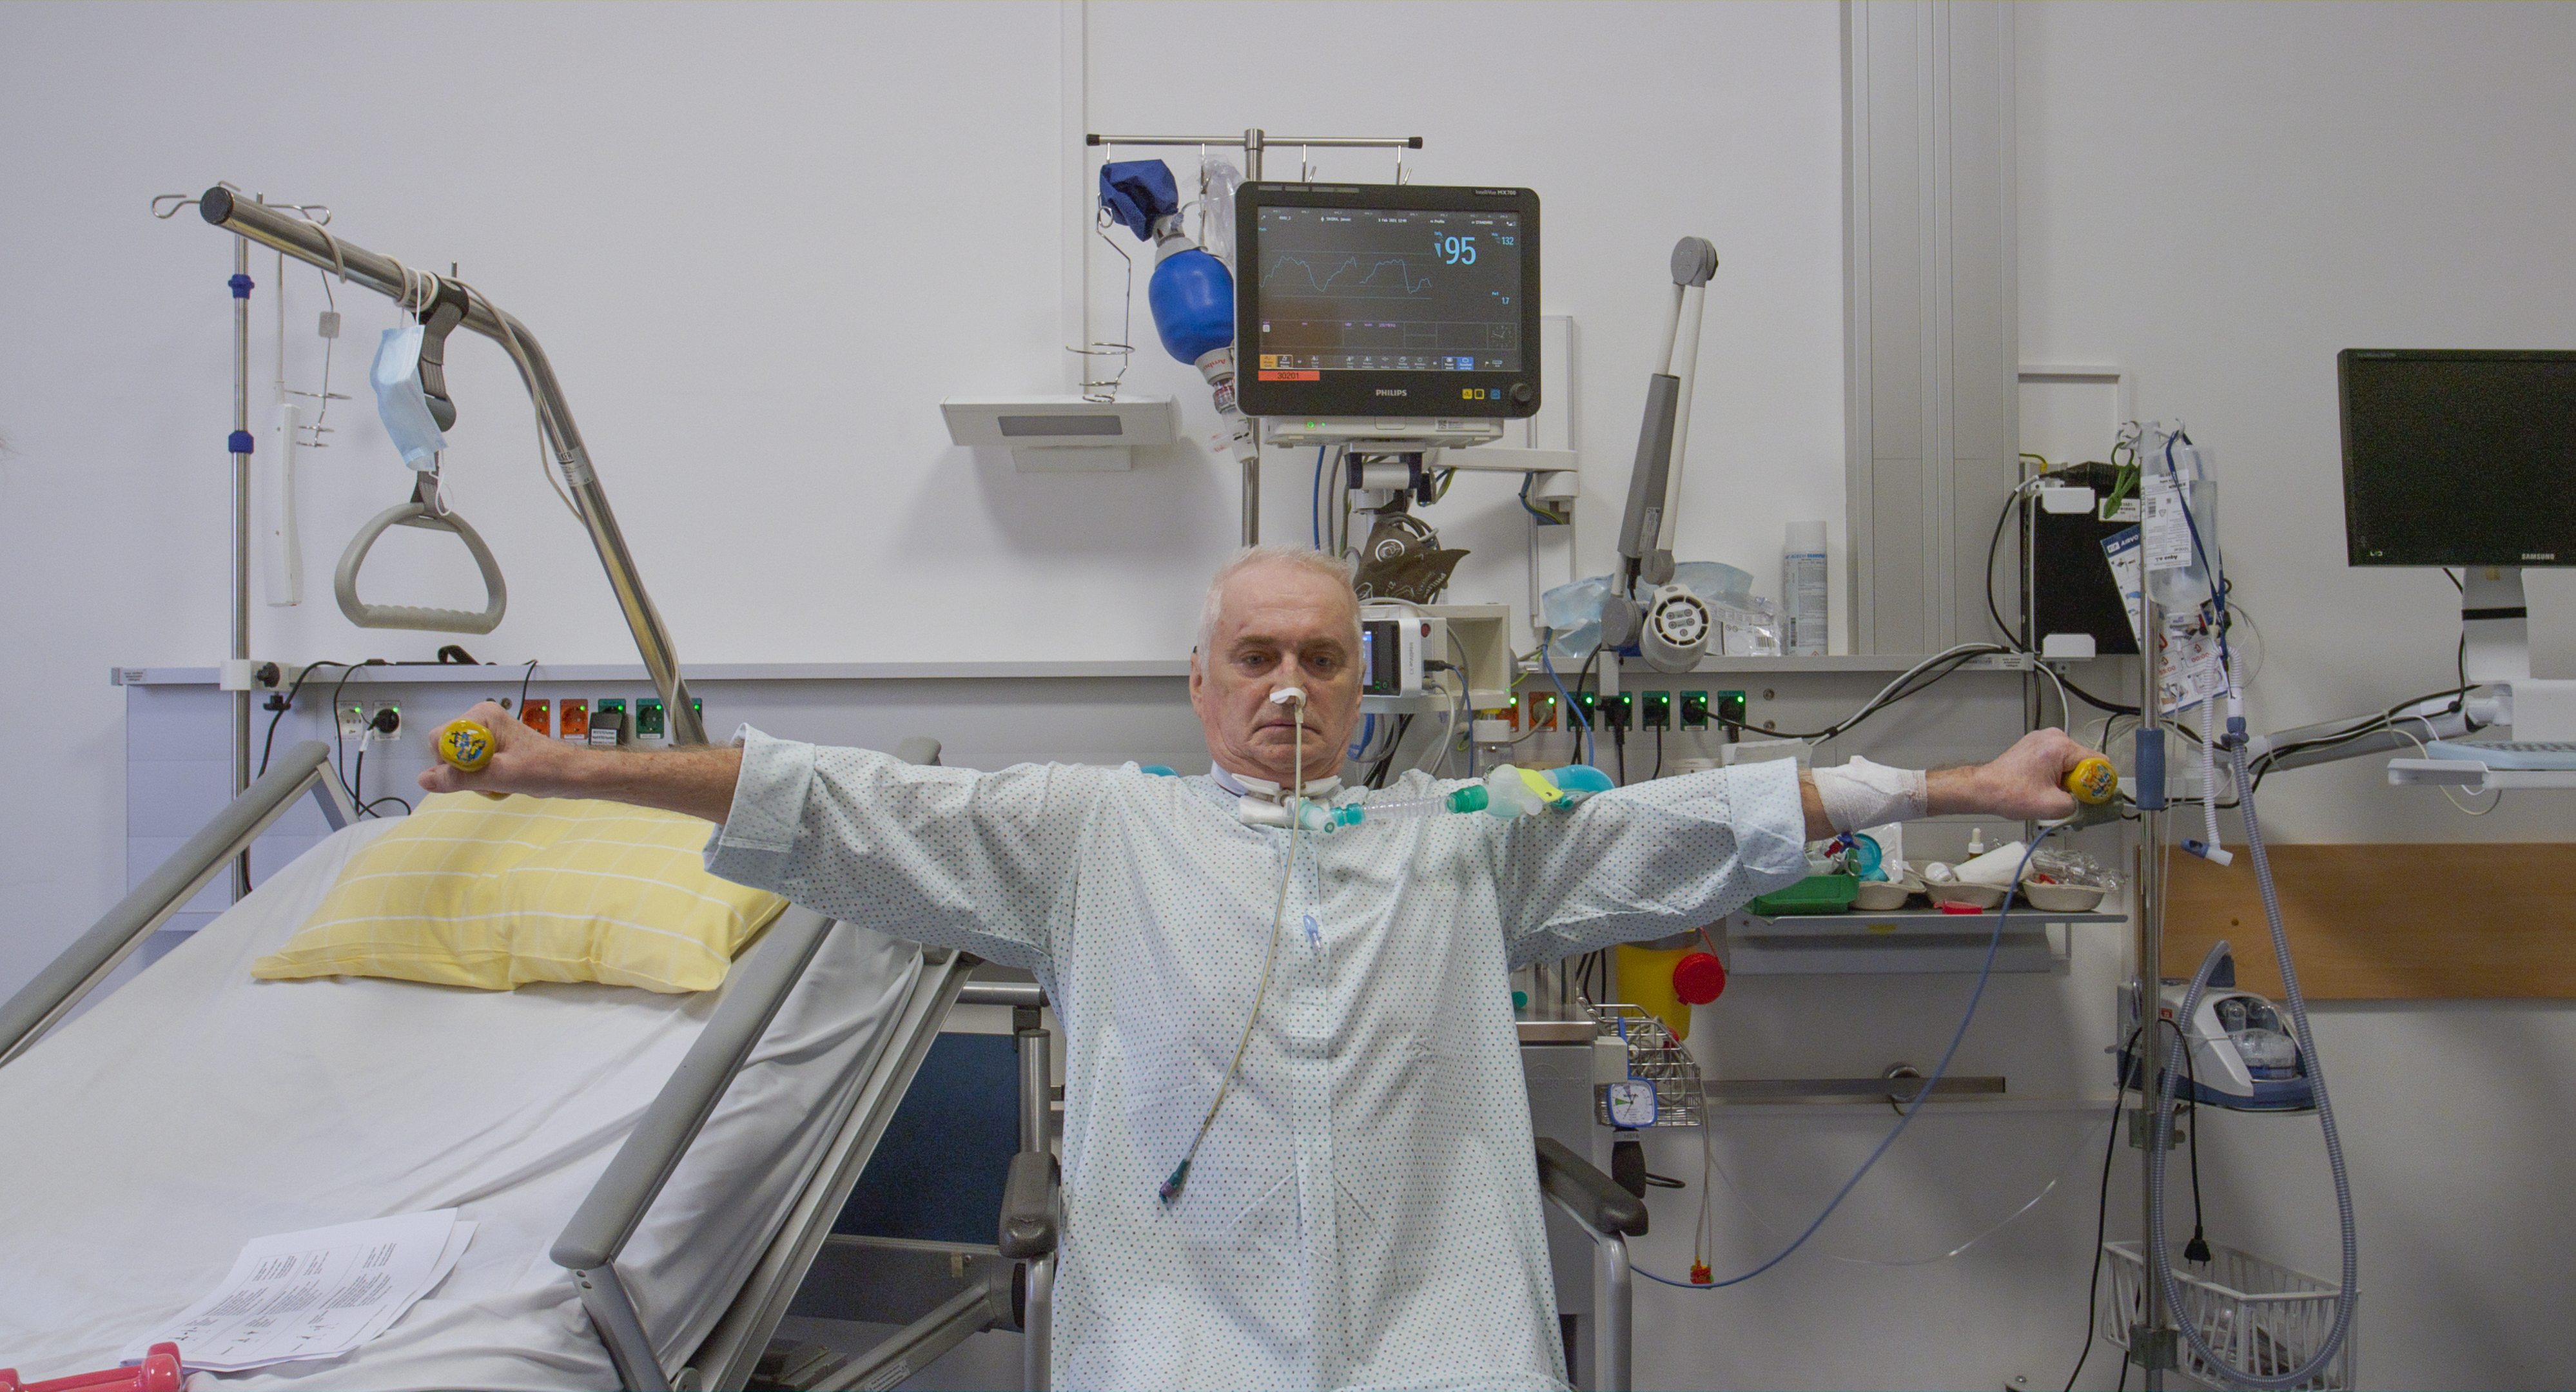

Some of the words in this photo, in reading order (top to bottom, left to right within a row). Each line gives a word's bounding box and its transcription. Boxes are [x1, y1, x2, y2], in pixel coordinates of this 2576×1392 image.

[1501, 237, 1514, 246] 132
[1445, 237, 1476, 265] 95
[1204, 358, 1226, 371] Ambu
[2121, 534, 2139, 546] AIRVO
